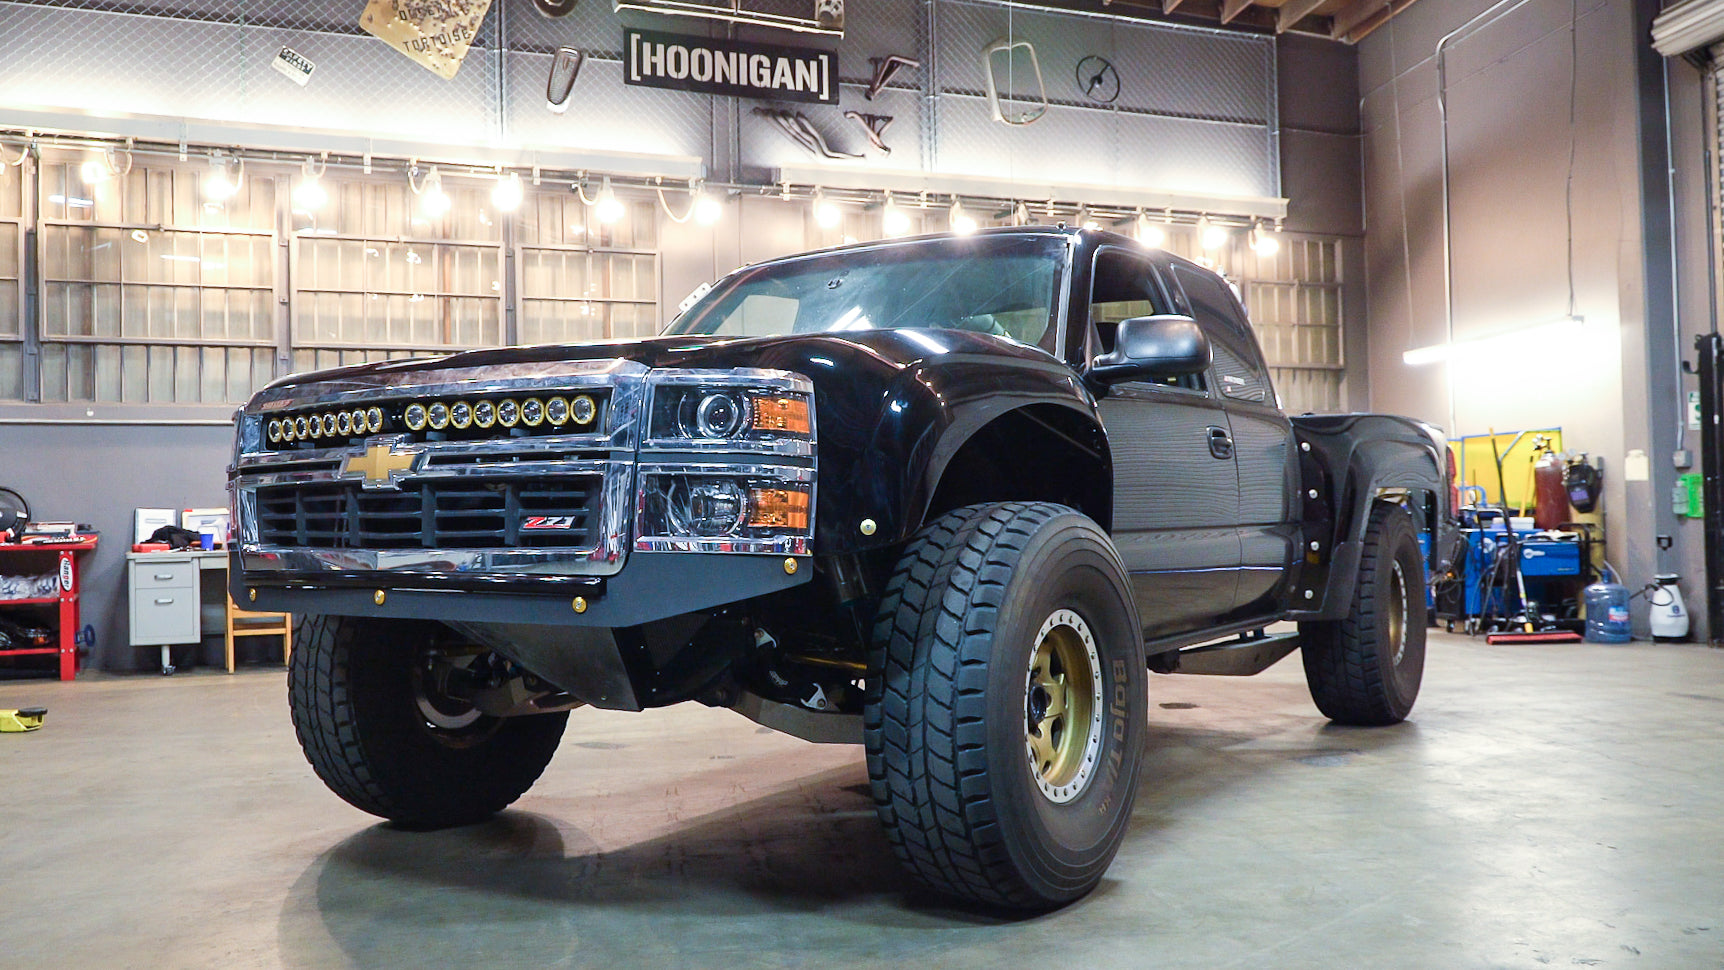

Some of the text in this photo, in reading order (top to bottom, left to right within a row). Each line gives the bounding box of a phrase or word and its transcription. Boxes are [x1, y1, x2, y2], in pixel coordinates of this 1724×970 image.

[403, 28, 471, 52] TORTOISE
[282, 48, 313, 70] SAFETY
[523, 516, 576, 529] Z71
[1110, 659, 1128, 742] Baja
